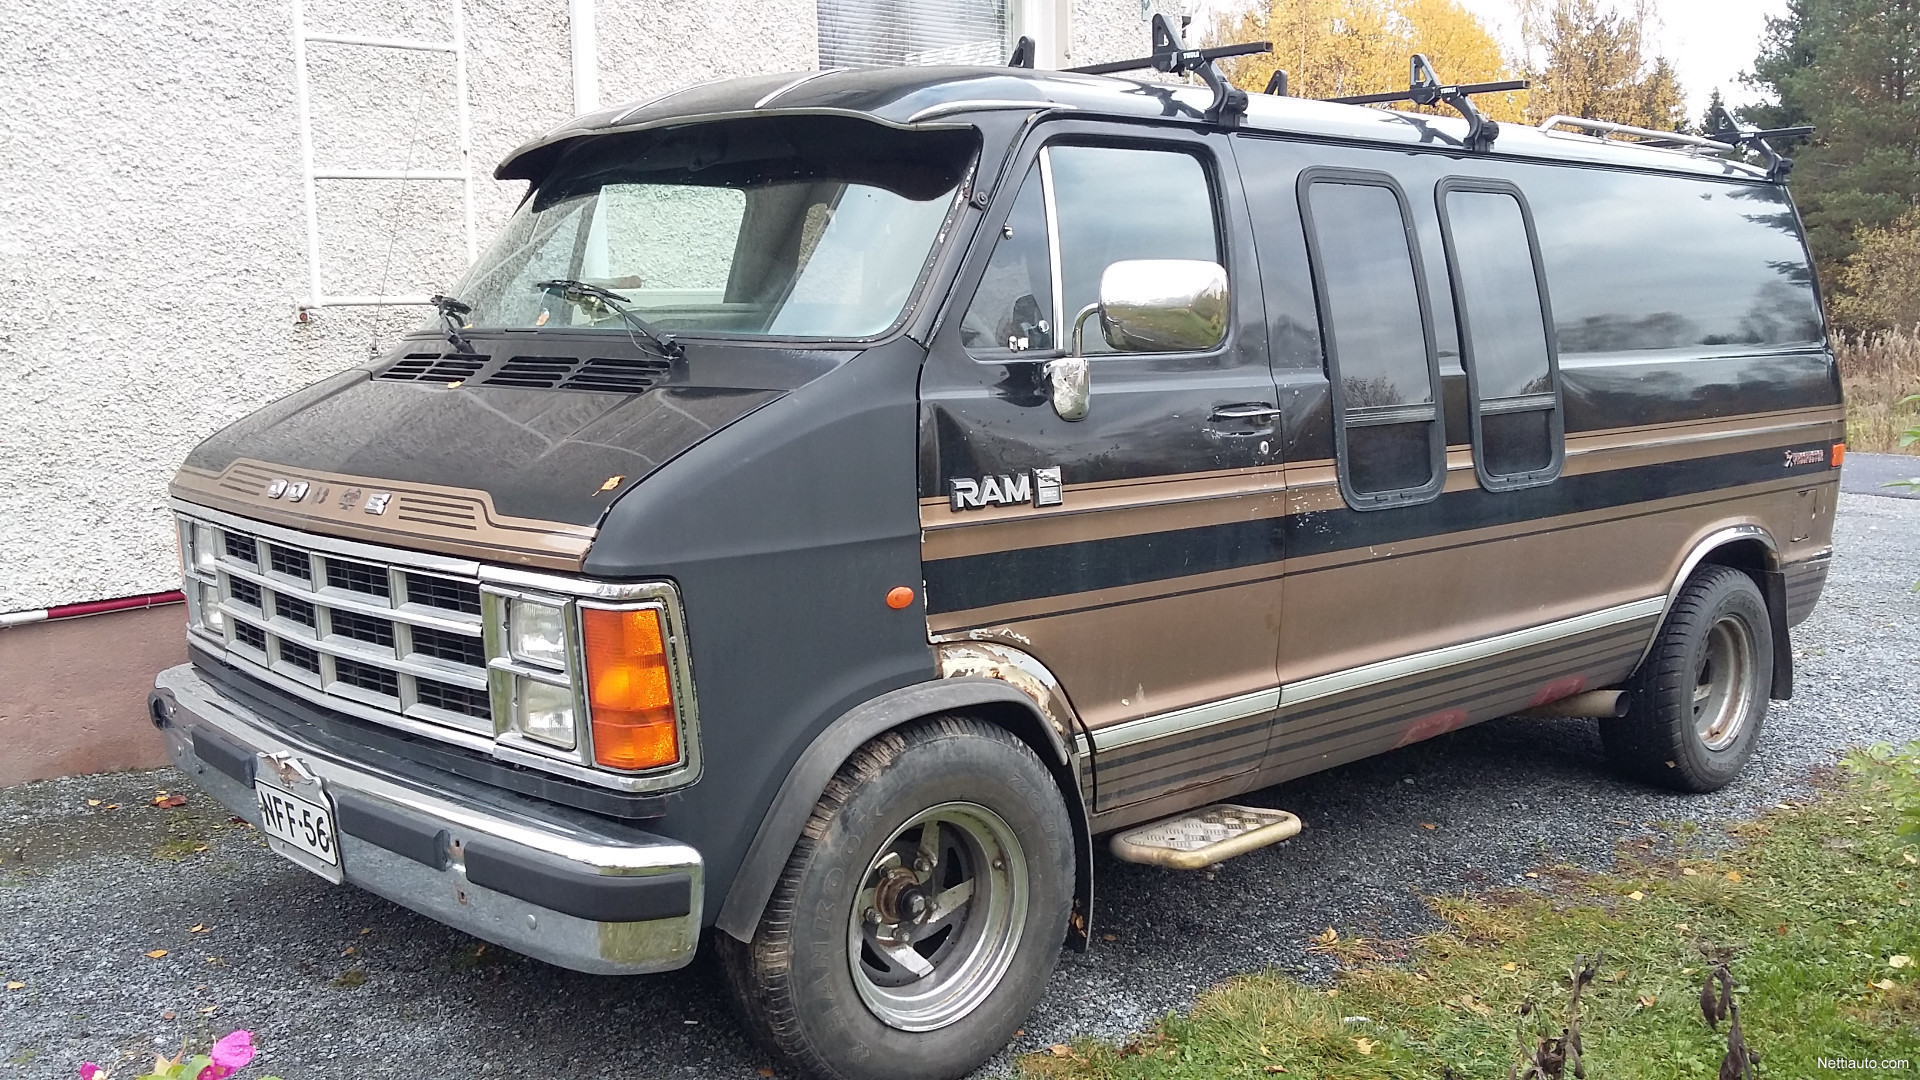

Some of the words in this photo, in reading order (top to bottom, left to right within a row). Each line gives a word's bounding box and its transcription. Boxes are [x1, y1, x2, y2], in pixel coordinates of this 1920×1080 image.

[267, 478, 393, 515] DOE
[950, 471, 1031, 511] RAM
[260, 789, 330, 853] NFF-56
[811, 804, 885, 1034] HANKOOK
